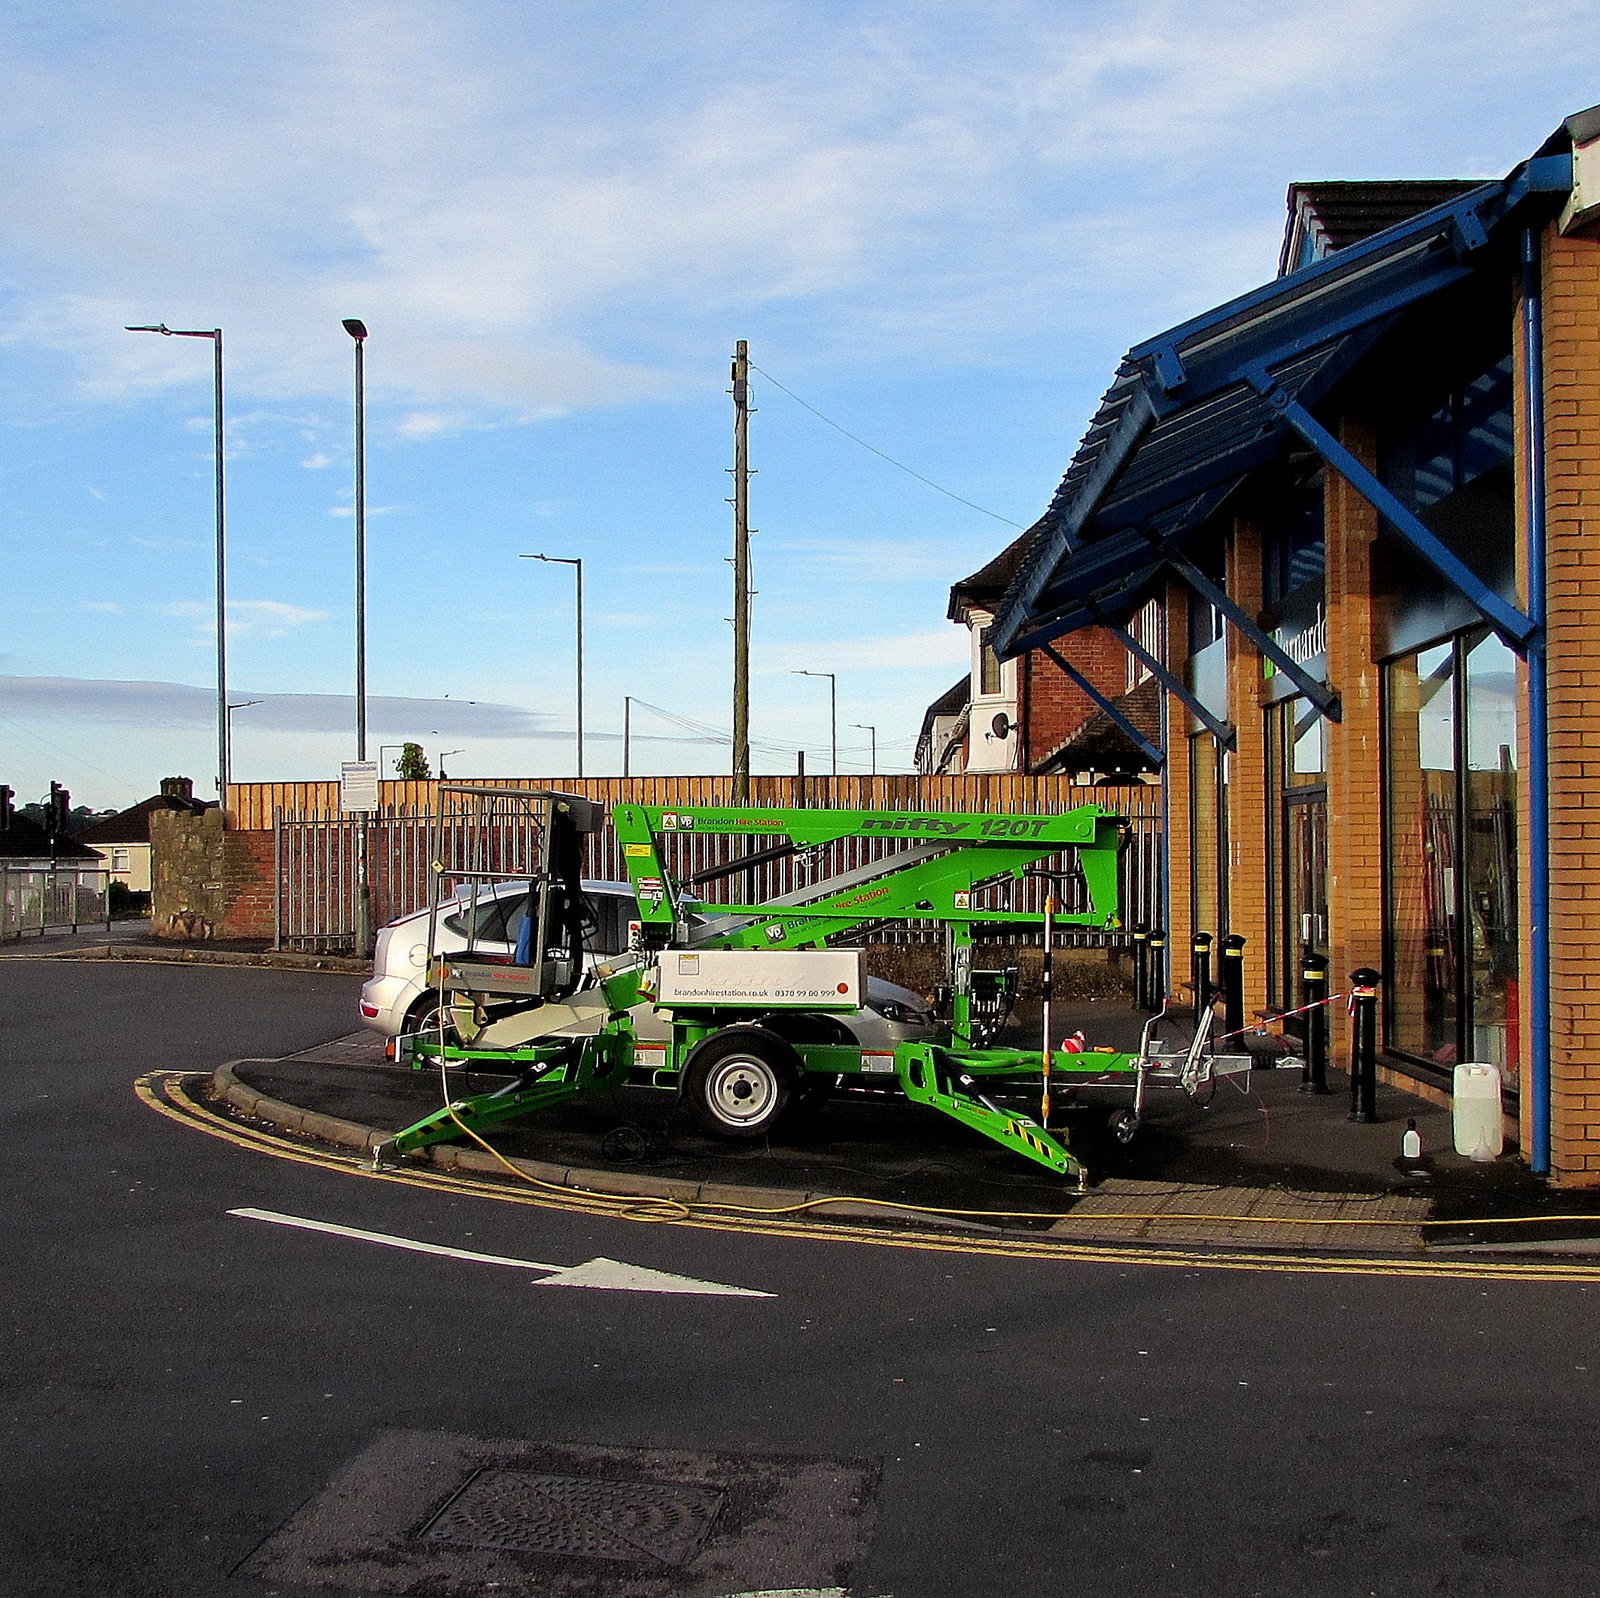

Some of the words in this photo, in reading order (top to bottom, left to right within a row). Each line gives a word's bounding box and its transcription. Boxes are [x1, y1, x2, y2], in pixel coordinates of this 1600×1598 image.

[697, 817, 734, 826] Brandon
[754, 818, 784, 827] Station
[860, 817, 970, 835] nifty
[980, 819, 1050, 837] 120T
[853, 886, 889, 904] Station
[674, 988, 769, 998] brandonhirestation.co.uk
[774, 989, 795, 998] 0370
[796, 990, 807, 998] 99
[808, 990, 819, 998] 00
[820, 990, 836, 998] 999
